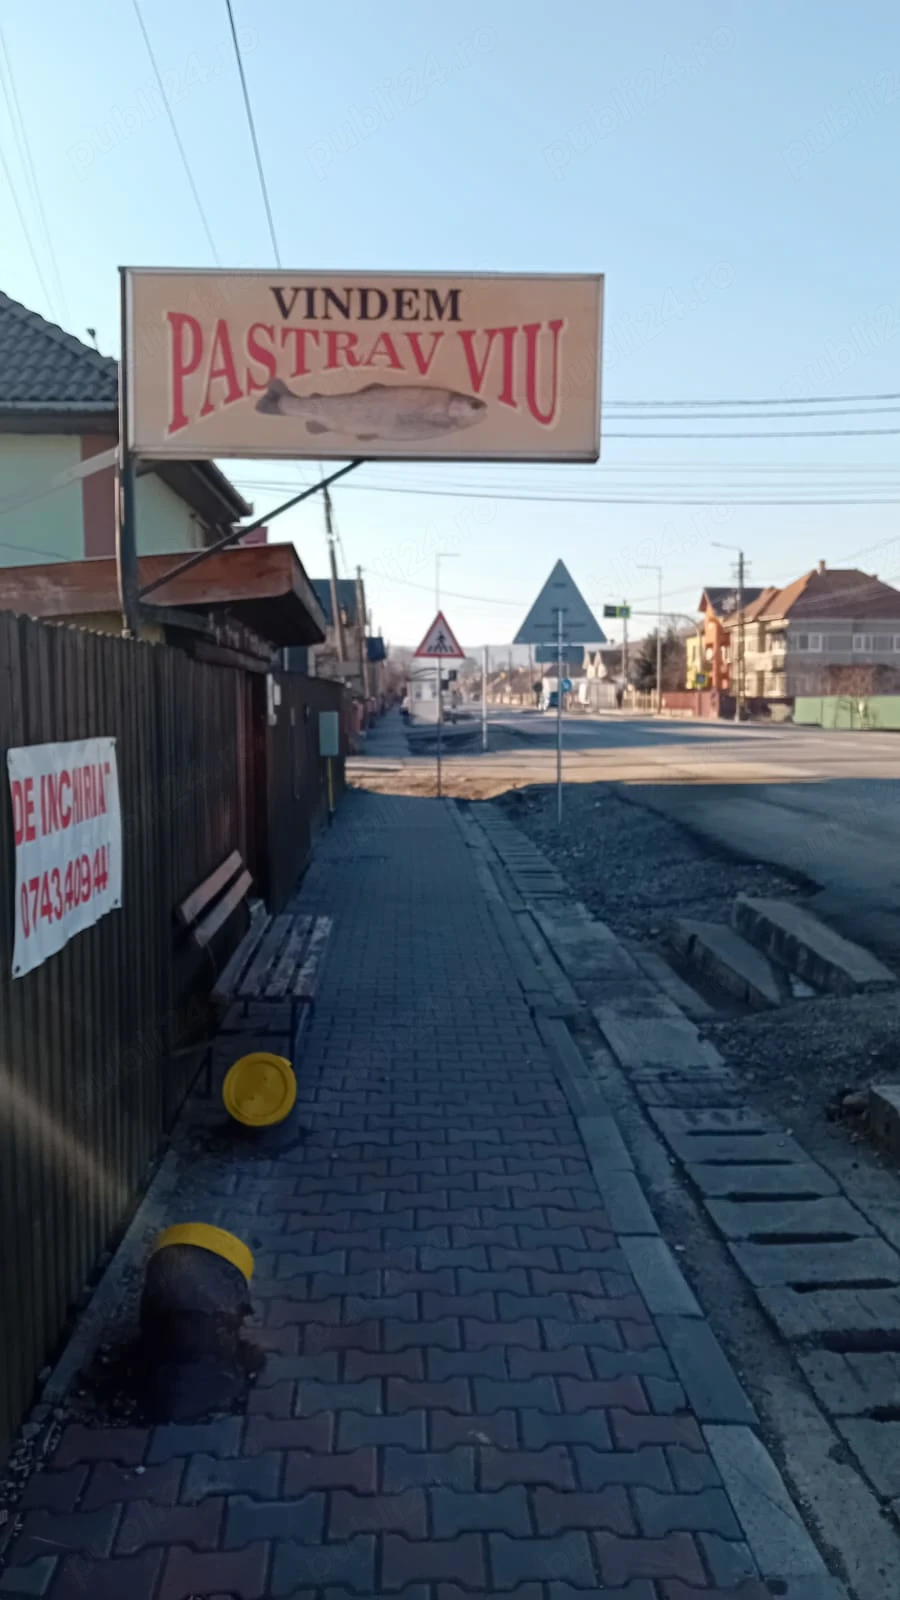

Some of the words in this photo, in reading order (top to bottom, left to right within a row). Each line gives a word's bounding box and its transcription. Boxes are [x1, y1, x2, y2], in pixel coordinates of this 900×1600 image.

[271, 287, 462, 321] VINDEM
[167, 311, 445, 434] PASTRAV
[457, 318, 566, 426] VIU
[12, 777, 36, 846] DE
